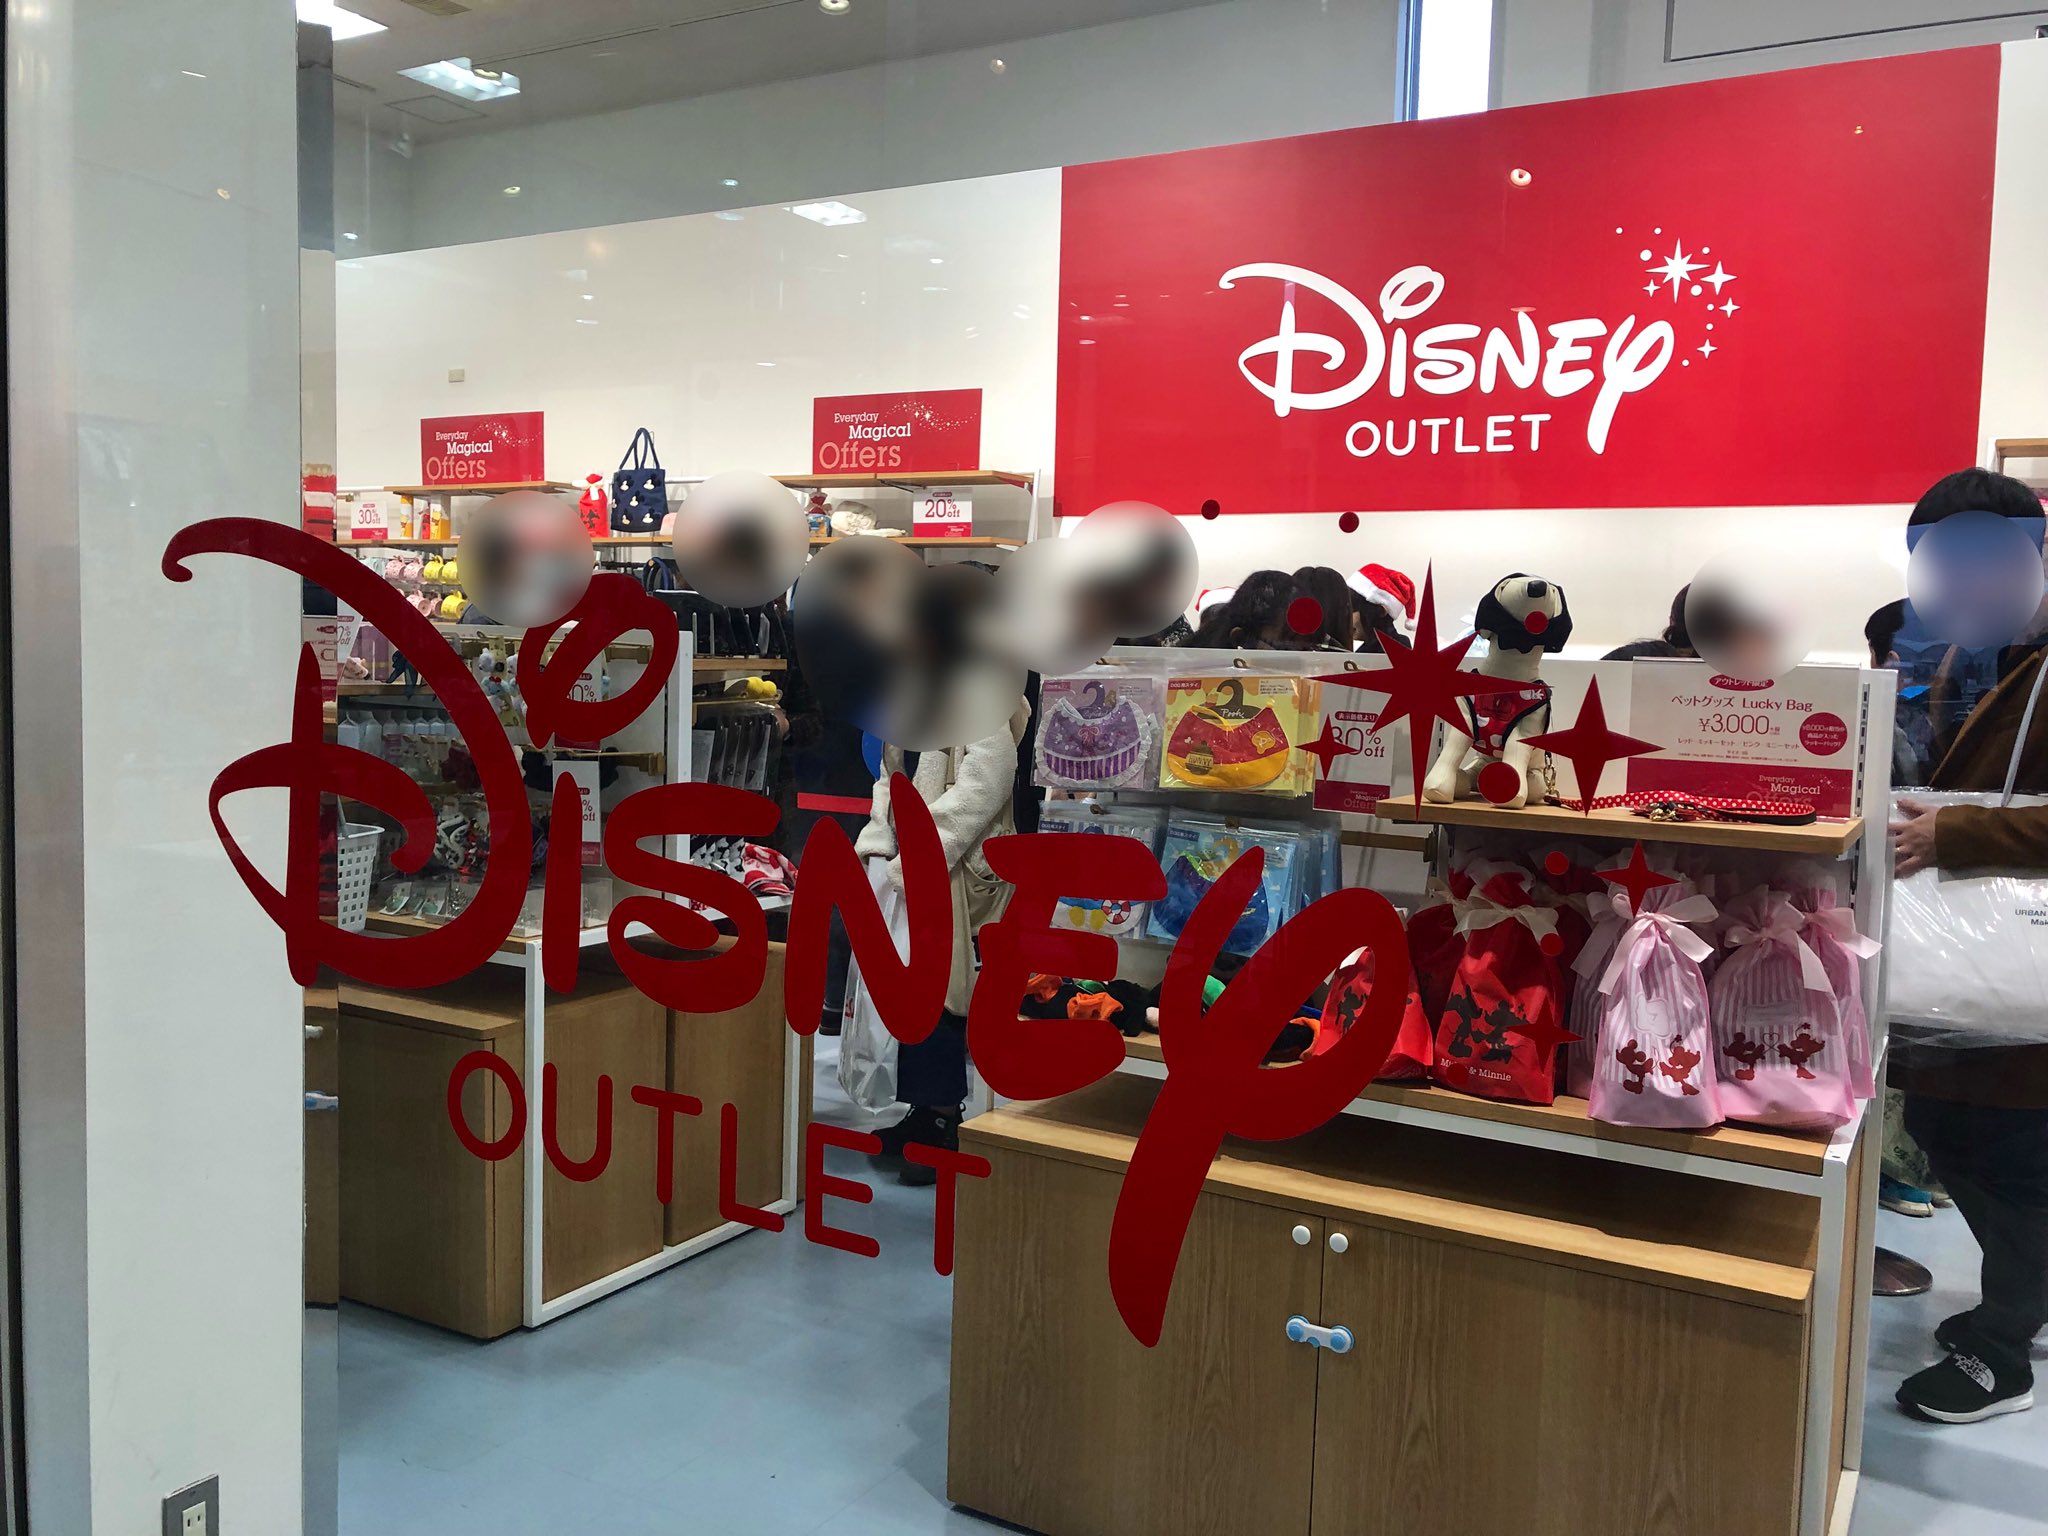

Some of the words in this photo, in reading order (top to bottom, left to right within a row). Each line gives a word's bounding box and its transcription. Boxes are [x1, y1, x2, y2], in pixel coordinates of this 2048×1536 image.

[834, 412, 879, 424] Everyday
[435, 431, 469, 442] Everyday
[849, 423, 911, 441] Magical
[1345, 413, 1552, 457] OUTLET
[446, 440, 493, 456] Magical
[819, 441, 902, 469] Offers
[426, 456, 487, 480] Offers
[925, 498, 957, 518] 20%
[947, 510, 960, 518] off
[358, 509, 378, 524] 30%
[1742, 697, 1782, 711] Lucky
[1786, 699, 1813, 713] Bag
[1364, 746, 1385, 758] off
[1759, 774, 1795, 784] Everyday
[1770, 783, 1821, 795] Magical
[583, 812, 595, 821] off
[1479, 1069, 1512, 1081] Minnie
[447, 1049, 991, 1276] OUTLET
